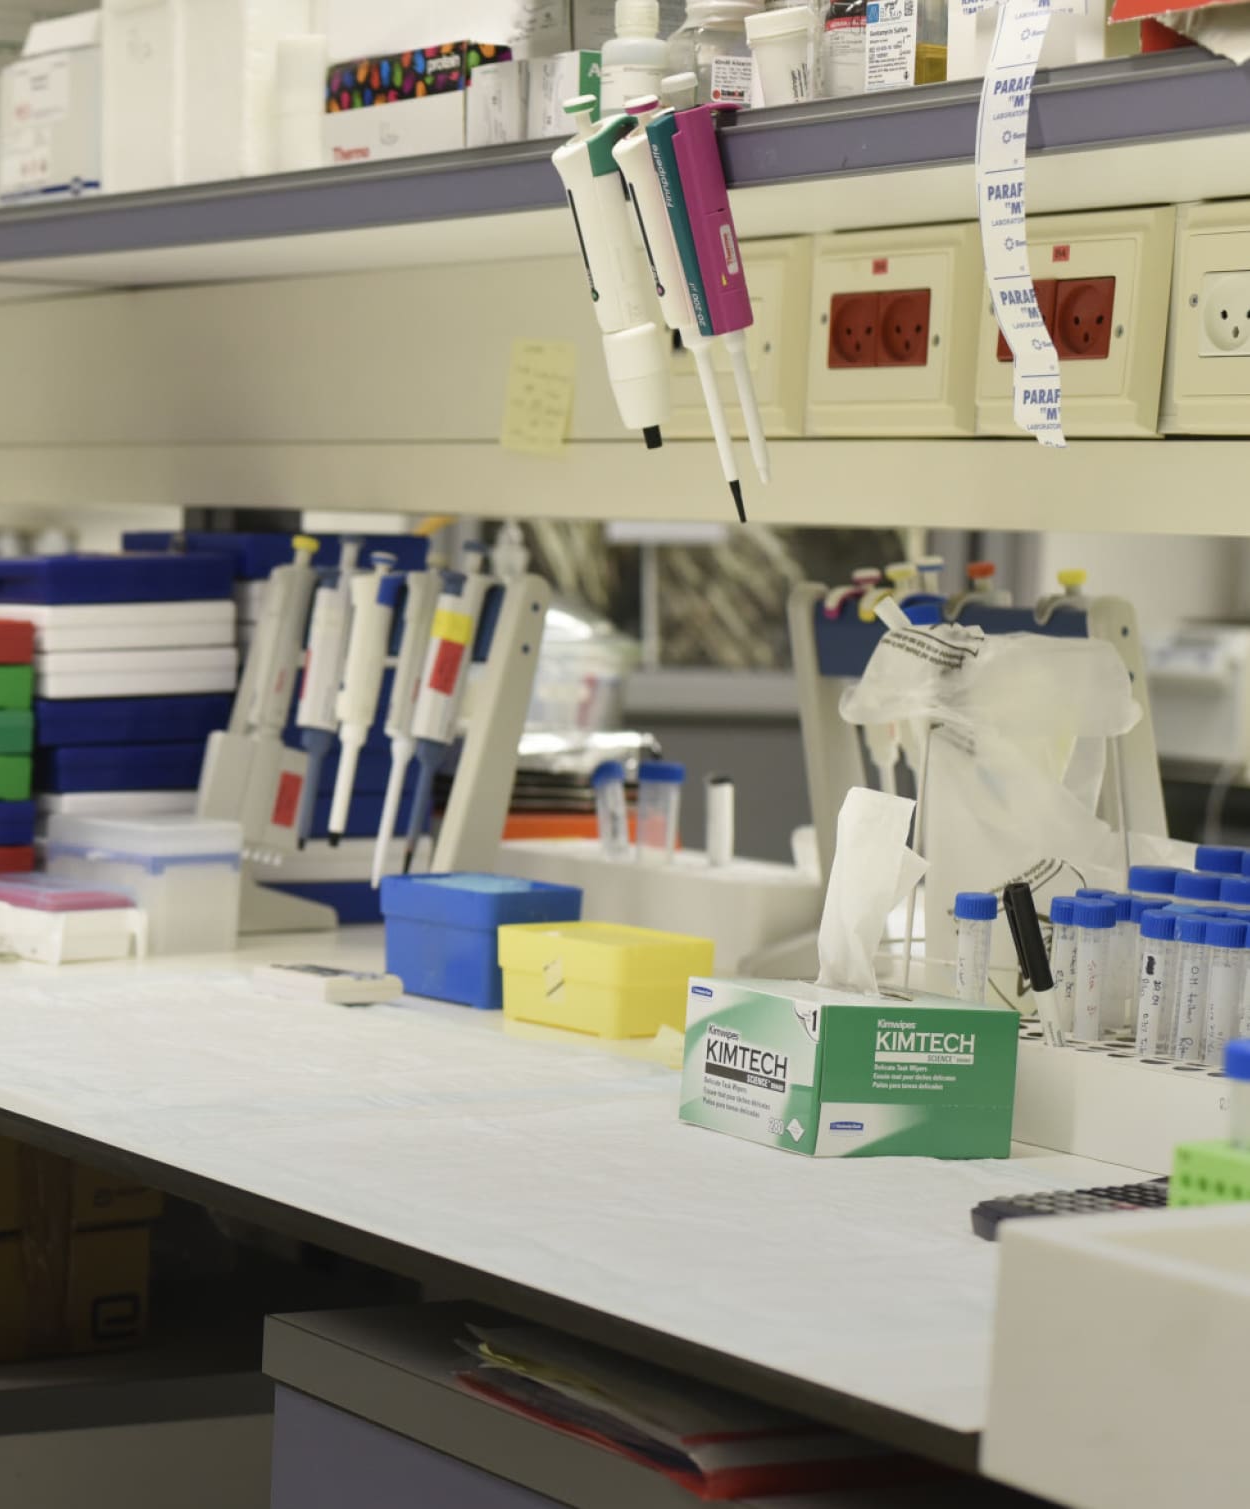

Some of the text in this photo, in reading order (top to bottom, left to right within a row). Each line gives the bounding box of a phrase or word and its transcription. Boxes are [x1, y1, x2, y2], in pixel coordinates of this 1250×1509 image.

[652, 143, 675, 209] Finnpipette
[705, 1037, 788, 1079] KIMTECH
[875, 1031, 976, 1053] KIMTECH
